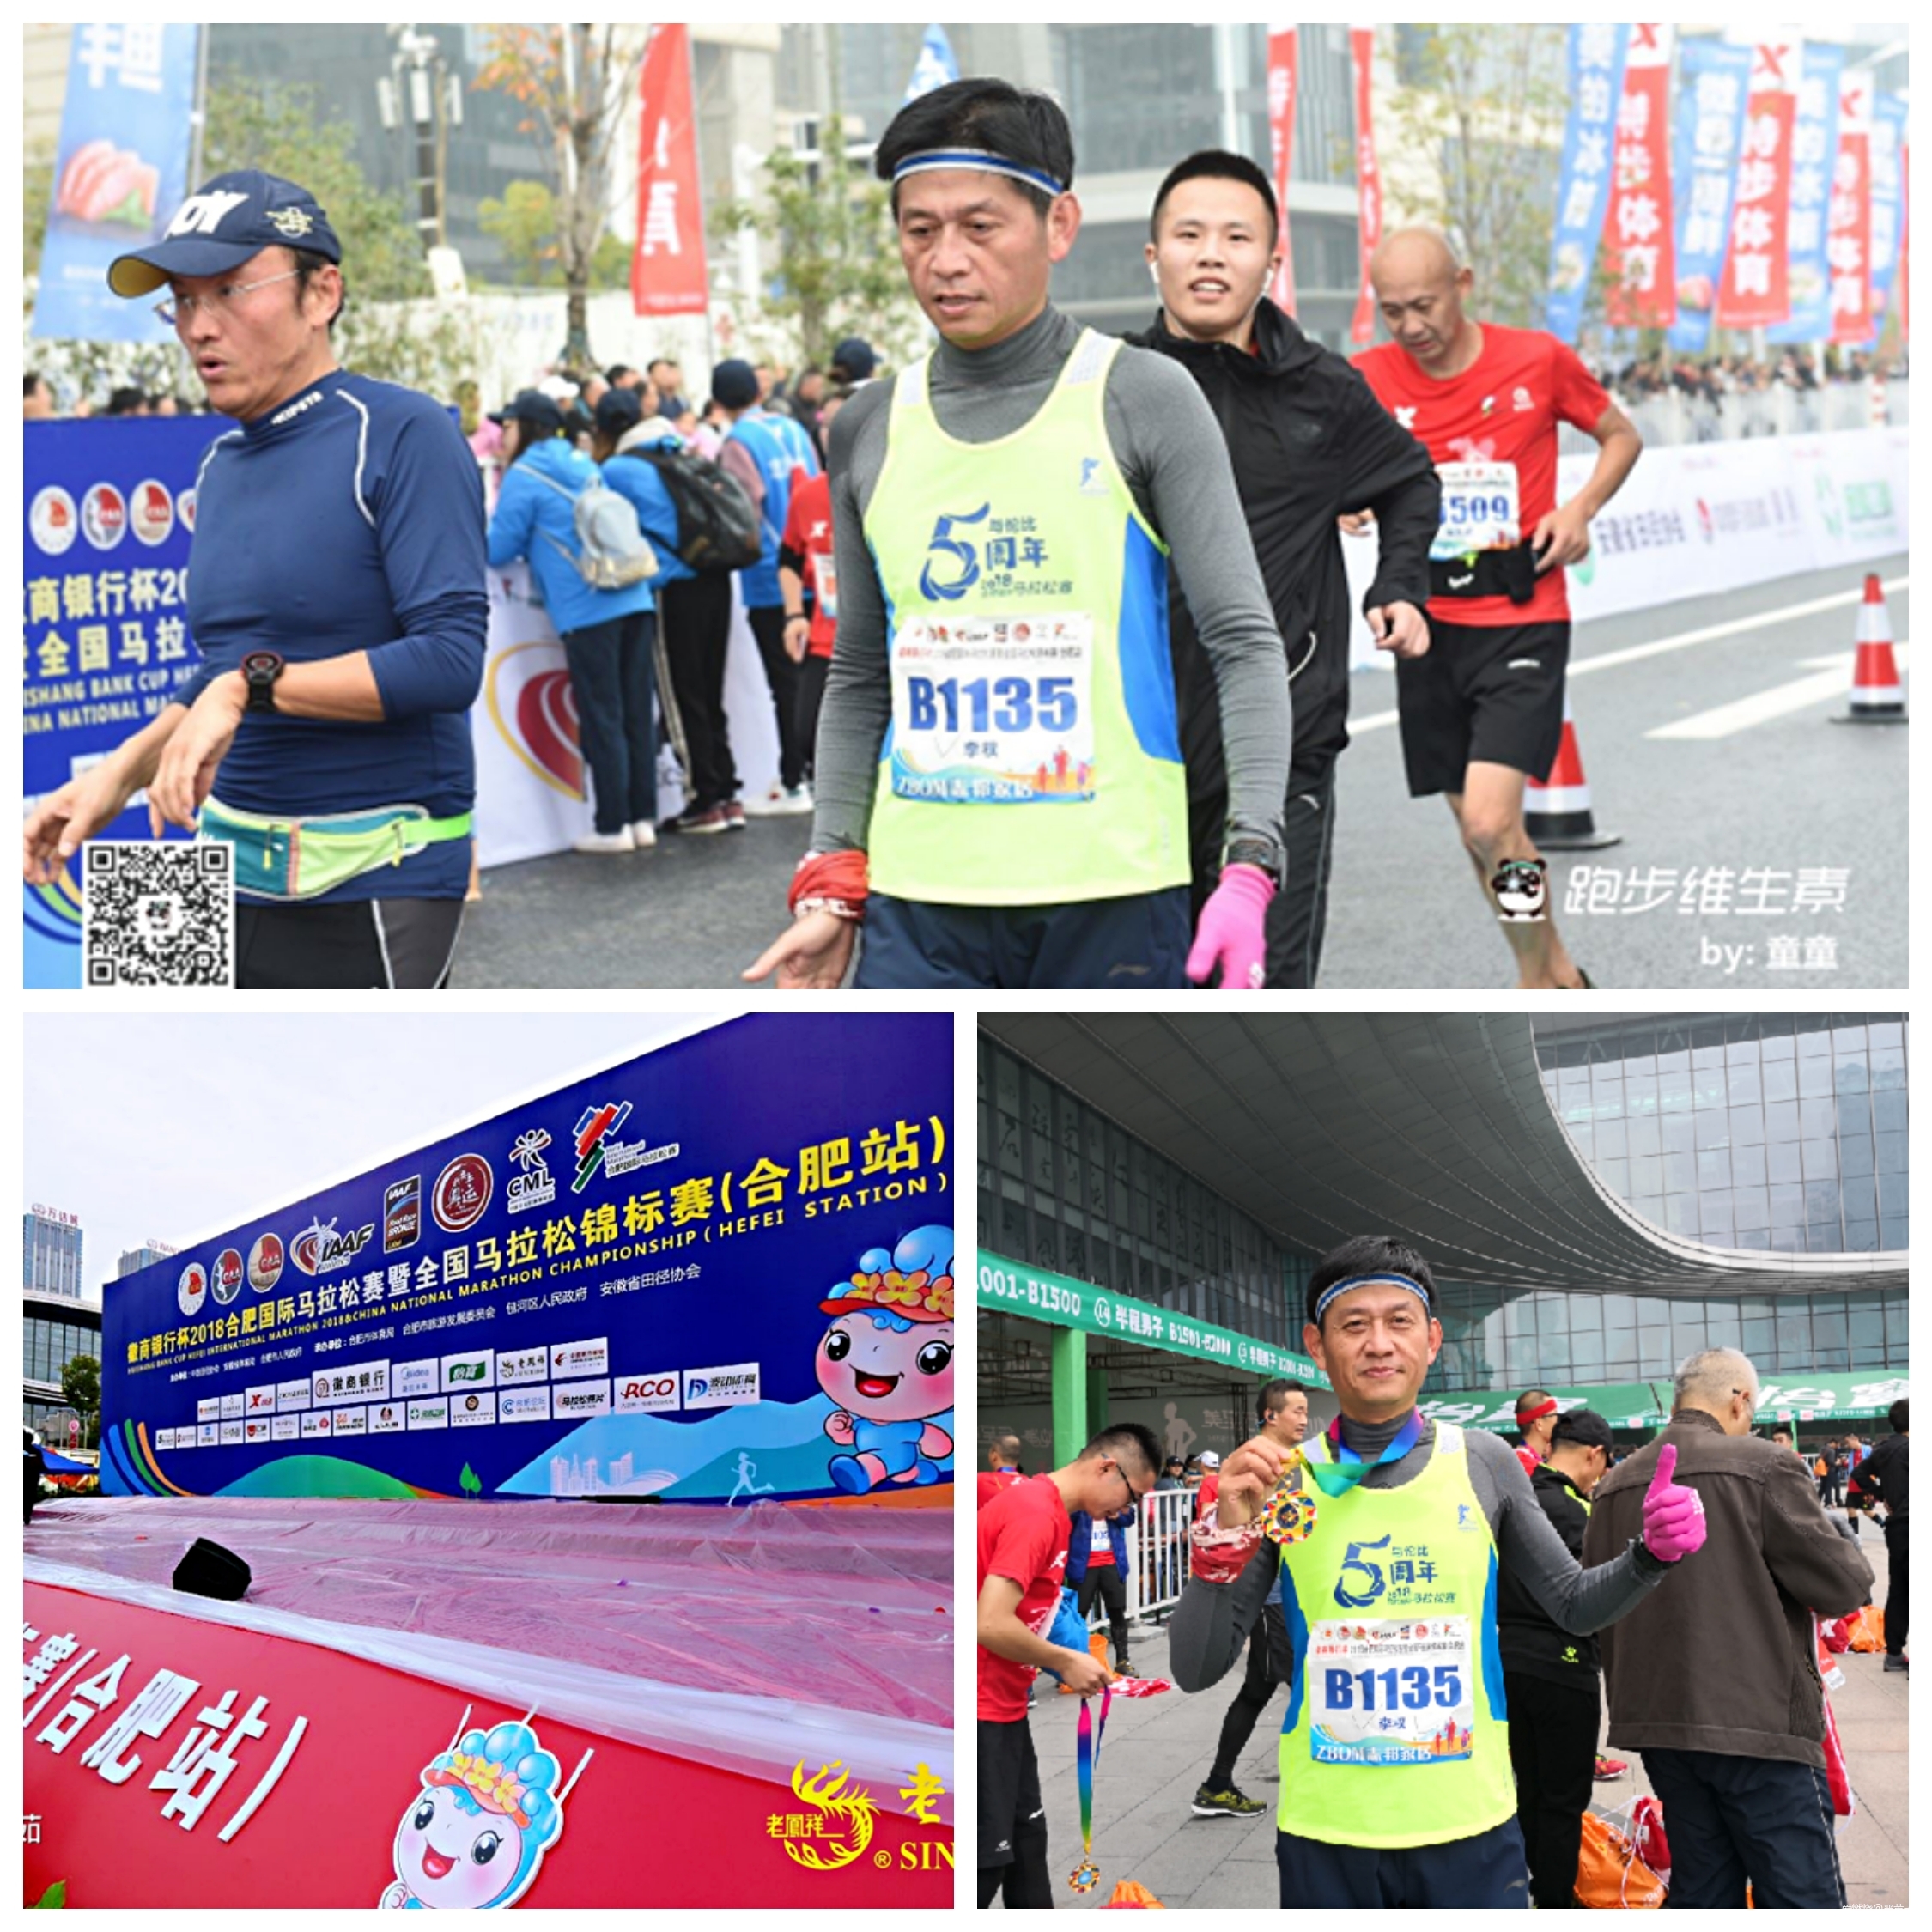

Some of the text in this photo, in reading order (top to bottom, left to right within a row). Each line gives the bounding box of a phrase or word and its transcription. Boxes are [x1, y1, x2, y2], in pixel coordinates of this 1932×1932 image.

[23, 568, 188, 624] 商银行杯2
[23, 616, 187, 680] 全国马拉
[90, 672, 135, 698] BANK
[137, 667, 169, 691] CUP
[908, 677, 1078, 732] B1135
[58, 699, 141, 729] NATIONAL
[508, 1170, 553, 1197] CML
[321, 1224, 374, 1261] IAAF
[269, 1321, 318, 1340] MARATHON
[391, 1290, 453, 1313] NATIONAL
[459, 1267, 543, 1297] MARATHON
[550, 1230, 696, 1276] CHAMPIONSHIP
[506, 1287, 587, 1315] 包河区人民政府
[599, 1264, 702, 1297] 安徽省田径协会
[977, 1266, 1082, 1316] 001-B1500
[1325, 1665, 1462, 1710] B1135
